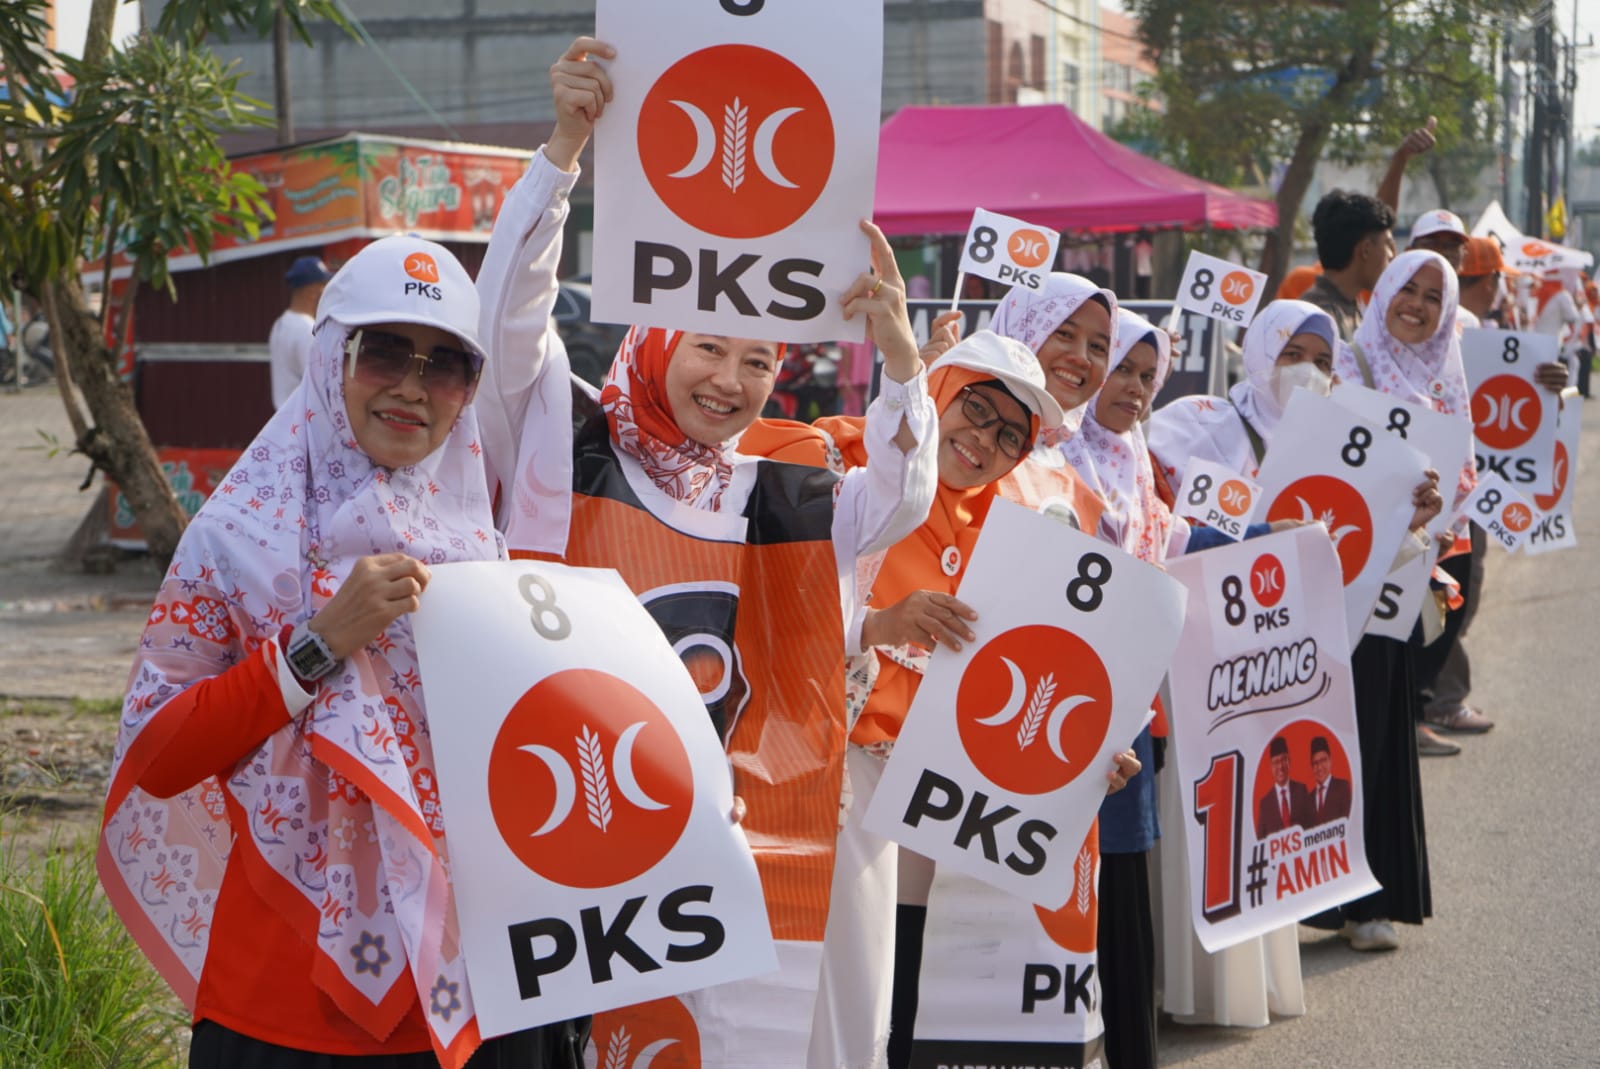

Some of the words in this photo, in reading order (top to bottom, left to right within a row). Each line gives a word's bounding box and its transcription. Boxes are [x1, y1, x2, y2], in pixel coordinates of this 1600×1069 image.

[969, 226, 998, 264] 8
[404, 281, 443, 302] PKS
[632, 240, 826, 321] PKS
[998, 264, 1041, 290] PKS
[1190, 268, 1217, 302] 8
[1211, 302, 1245, 322] PKS
[1502, 336, 1520, 363] 8
[1341, 426, 1373, 468] 8
[1187, 474, 1213, 506] 8
[1476, 488, 1502, 515] 8
[1206, 509, 1242, 537] PKS
[1488, 519, 1517, 547] PKS
[1066, 552, 1112, 613] 8
[1221, 575, 1247, 627] 8
[517, 573, 571, 641] 8
[1254, 607, 1290, 634] PKS
[1207, 637, 1318, 711] MENANG
[902, 768, 1058, 877] PKS
[1195, 749, 1245, 925] 1
[1270, 831, 1302, 860] PKS
[1304, 823, 1345, 849] menang
[508, 884, 726, 1001] PKS
[1021, 963, 1097, 1015] PK
